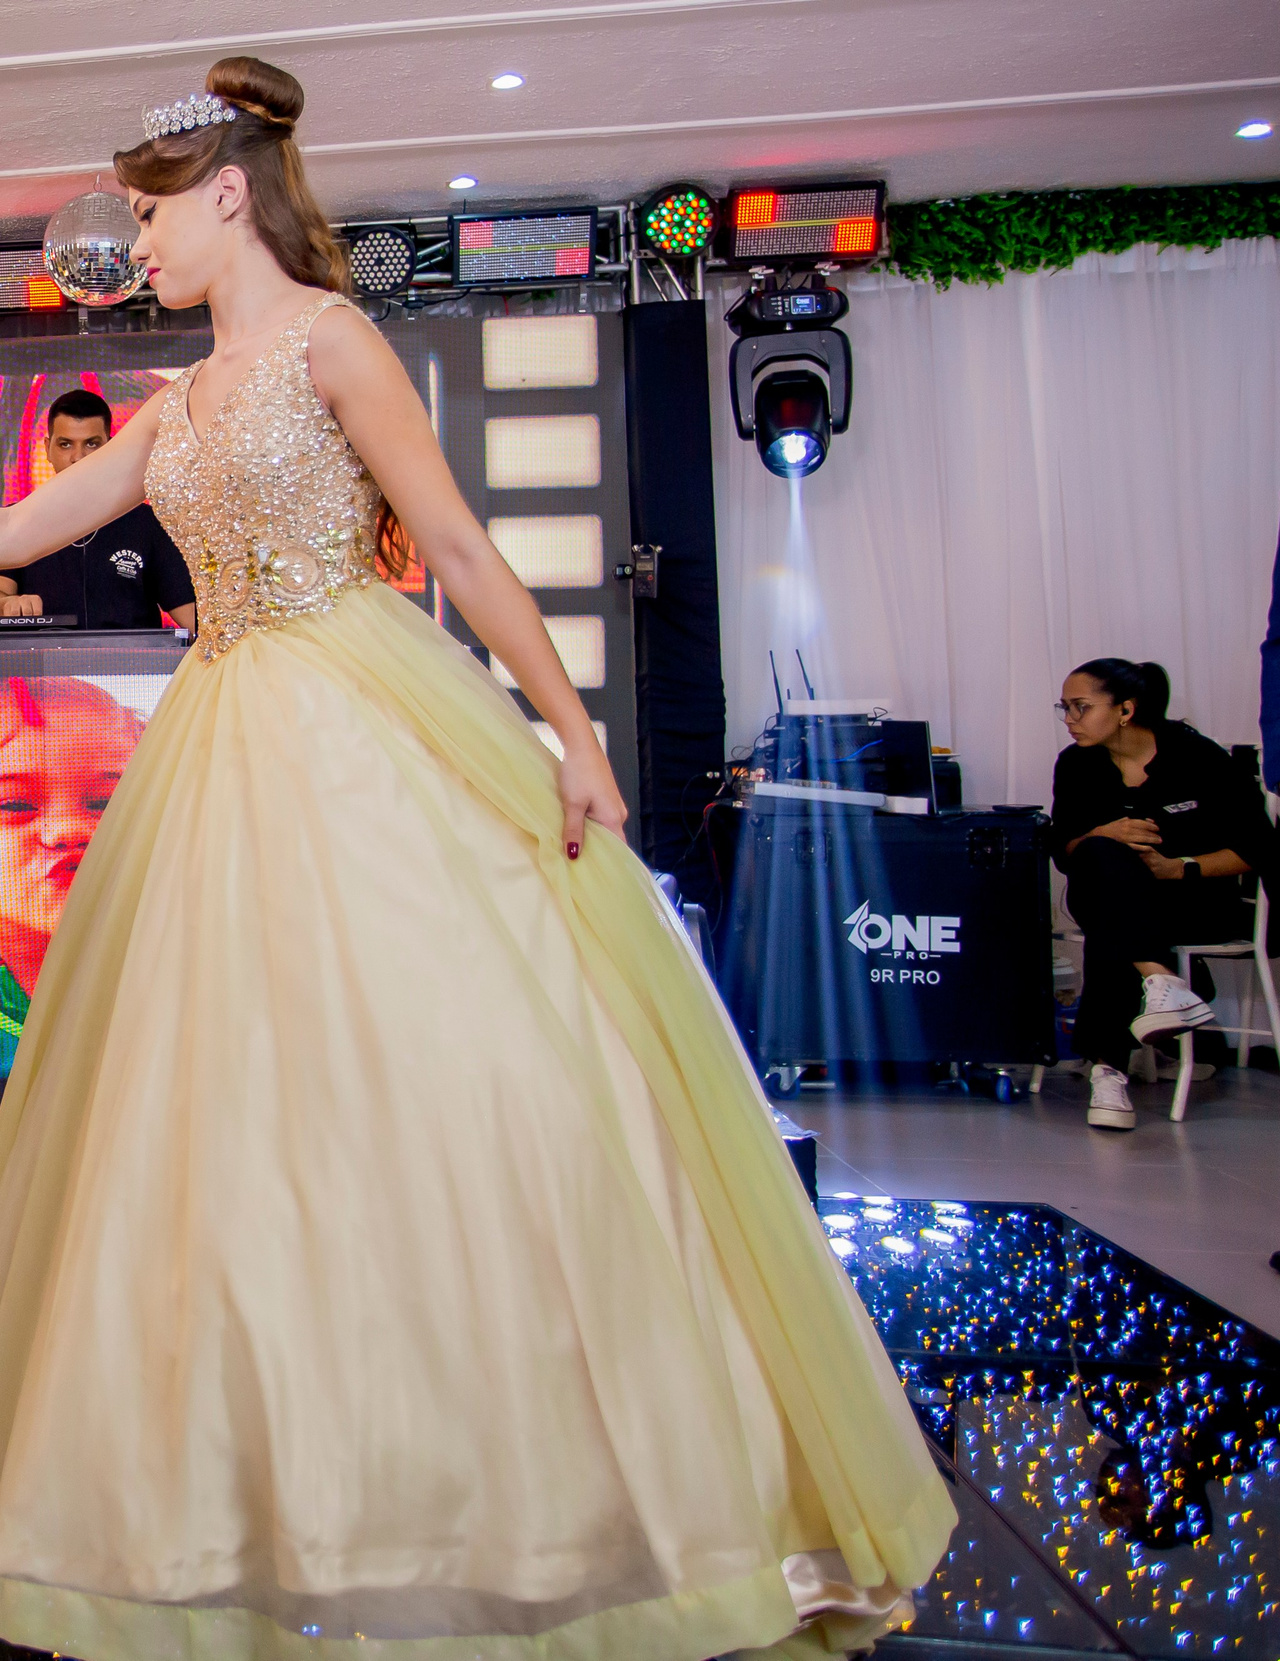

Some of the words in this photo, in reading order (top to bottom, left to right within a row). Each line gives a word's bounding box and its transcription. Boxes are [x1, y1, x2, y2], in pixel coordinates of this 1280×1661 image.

[858, 913, 961, 953] ONE
[893, 951, 929, 960] PRO
[870, 968, 894, 983] 9R
[899, 969, 941, 985] PRO
